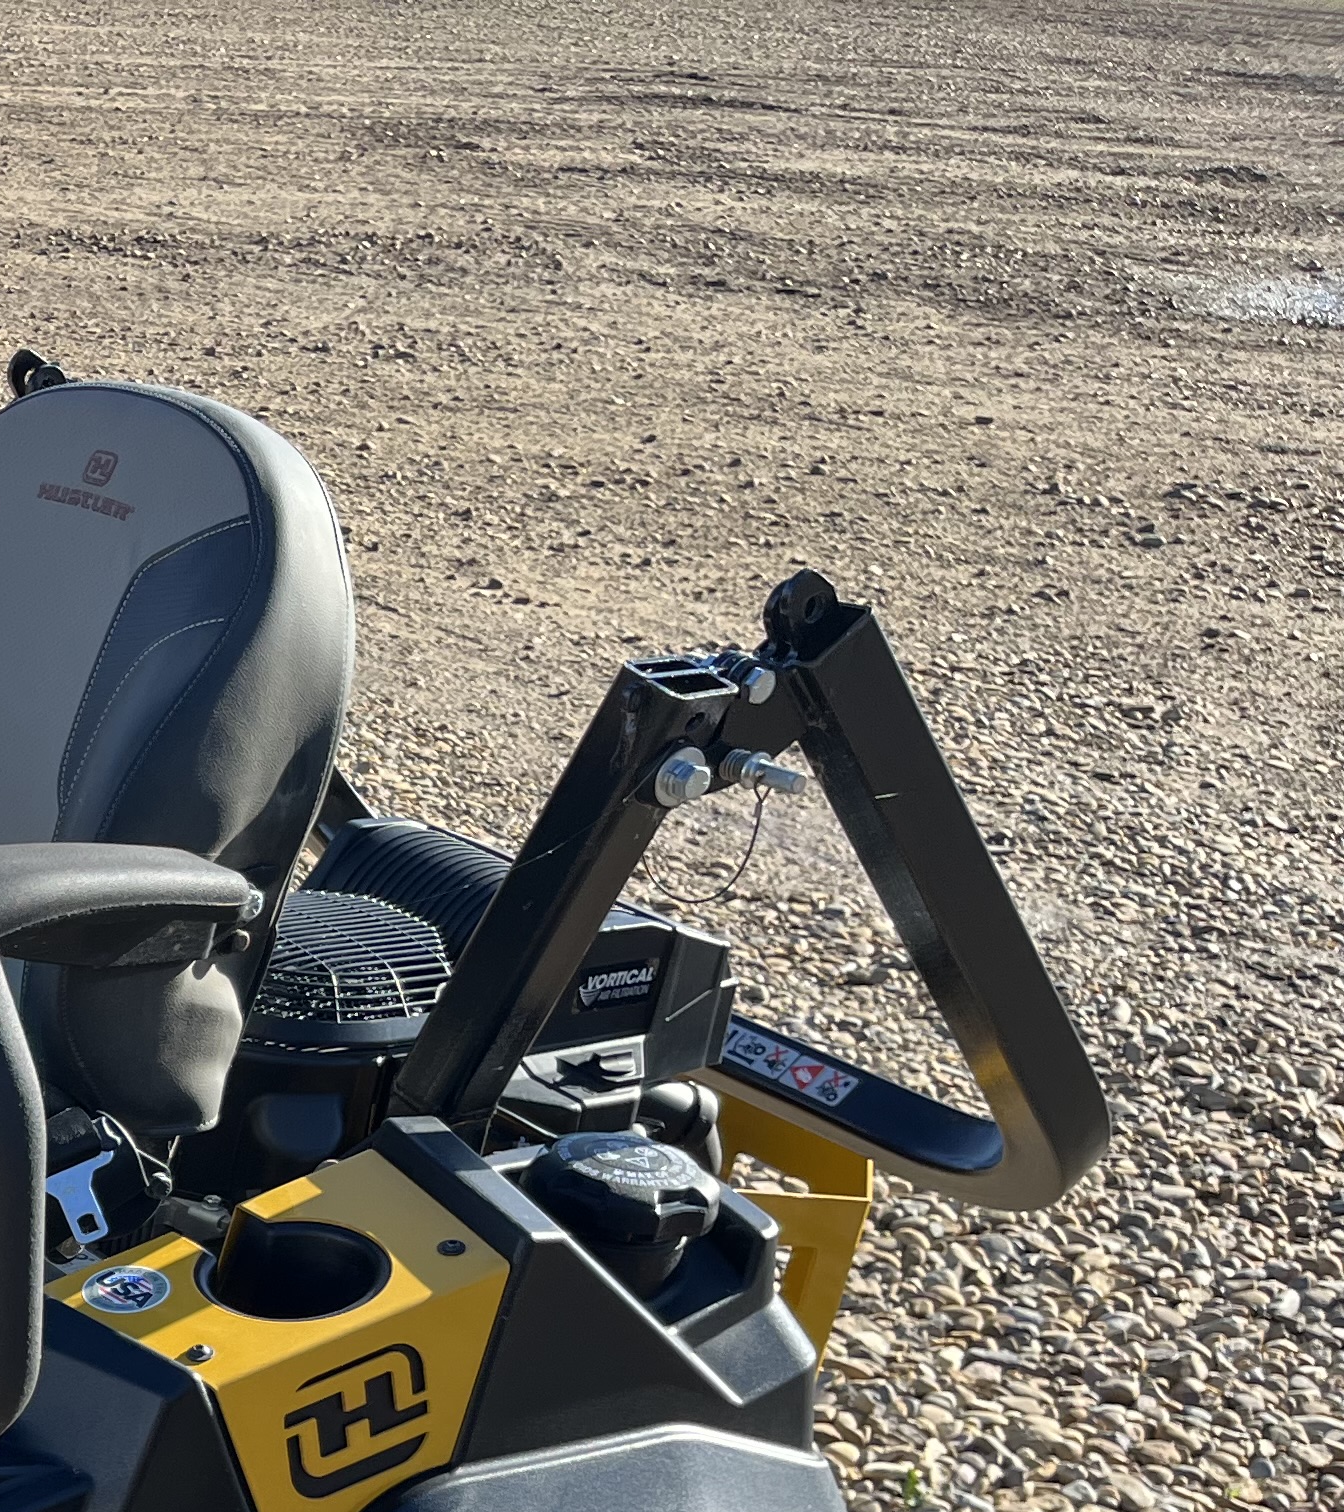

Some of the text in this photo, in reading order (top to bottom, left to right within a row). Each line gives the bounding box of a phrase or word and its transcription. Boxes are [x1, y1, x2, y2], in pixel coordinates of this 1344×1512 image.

[37, 483, 134, 521] HUSTLER
[587, 966, 654, 990] VORTICAL
[95, 1270, 154, 1309] USA
